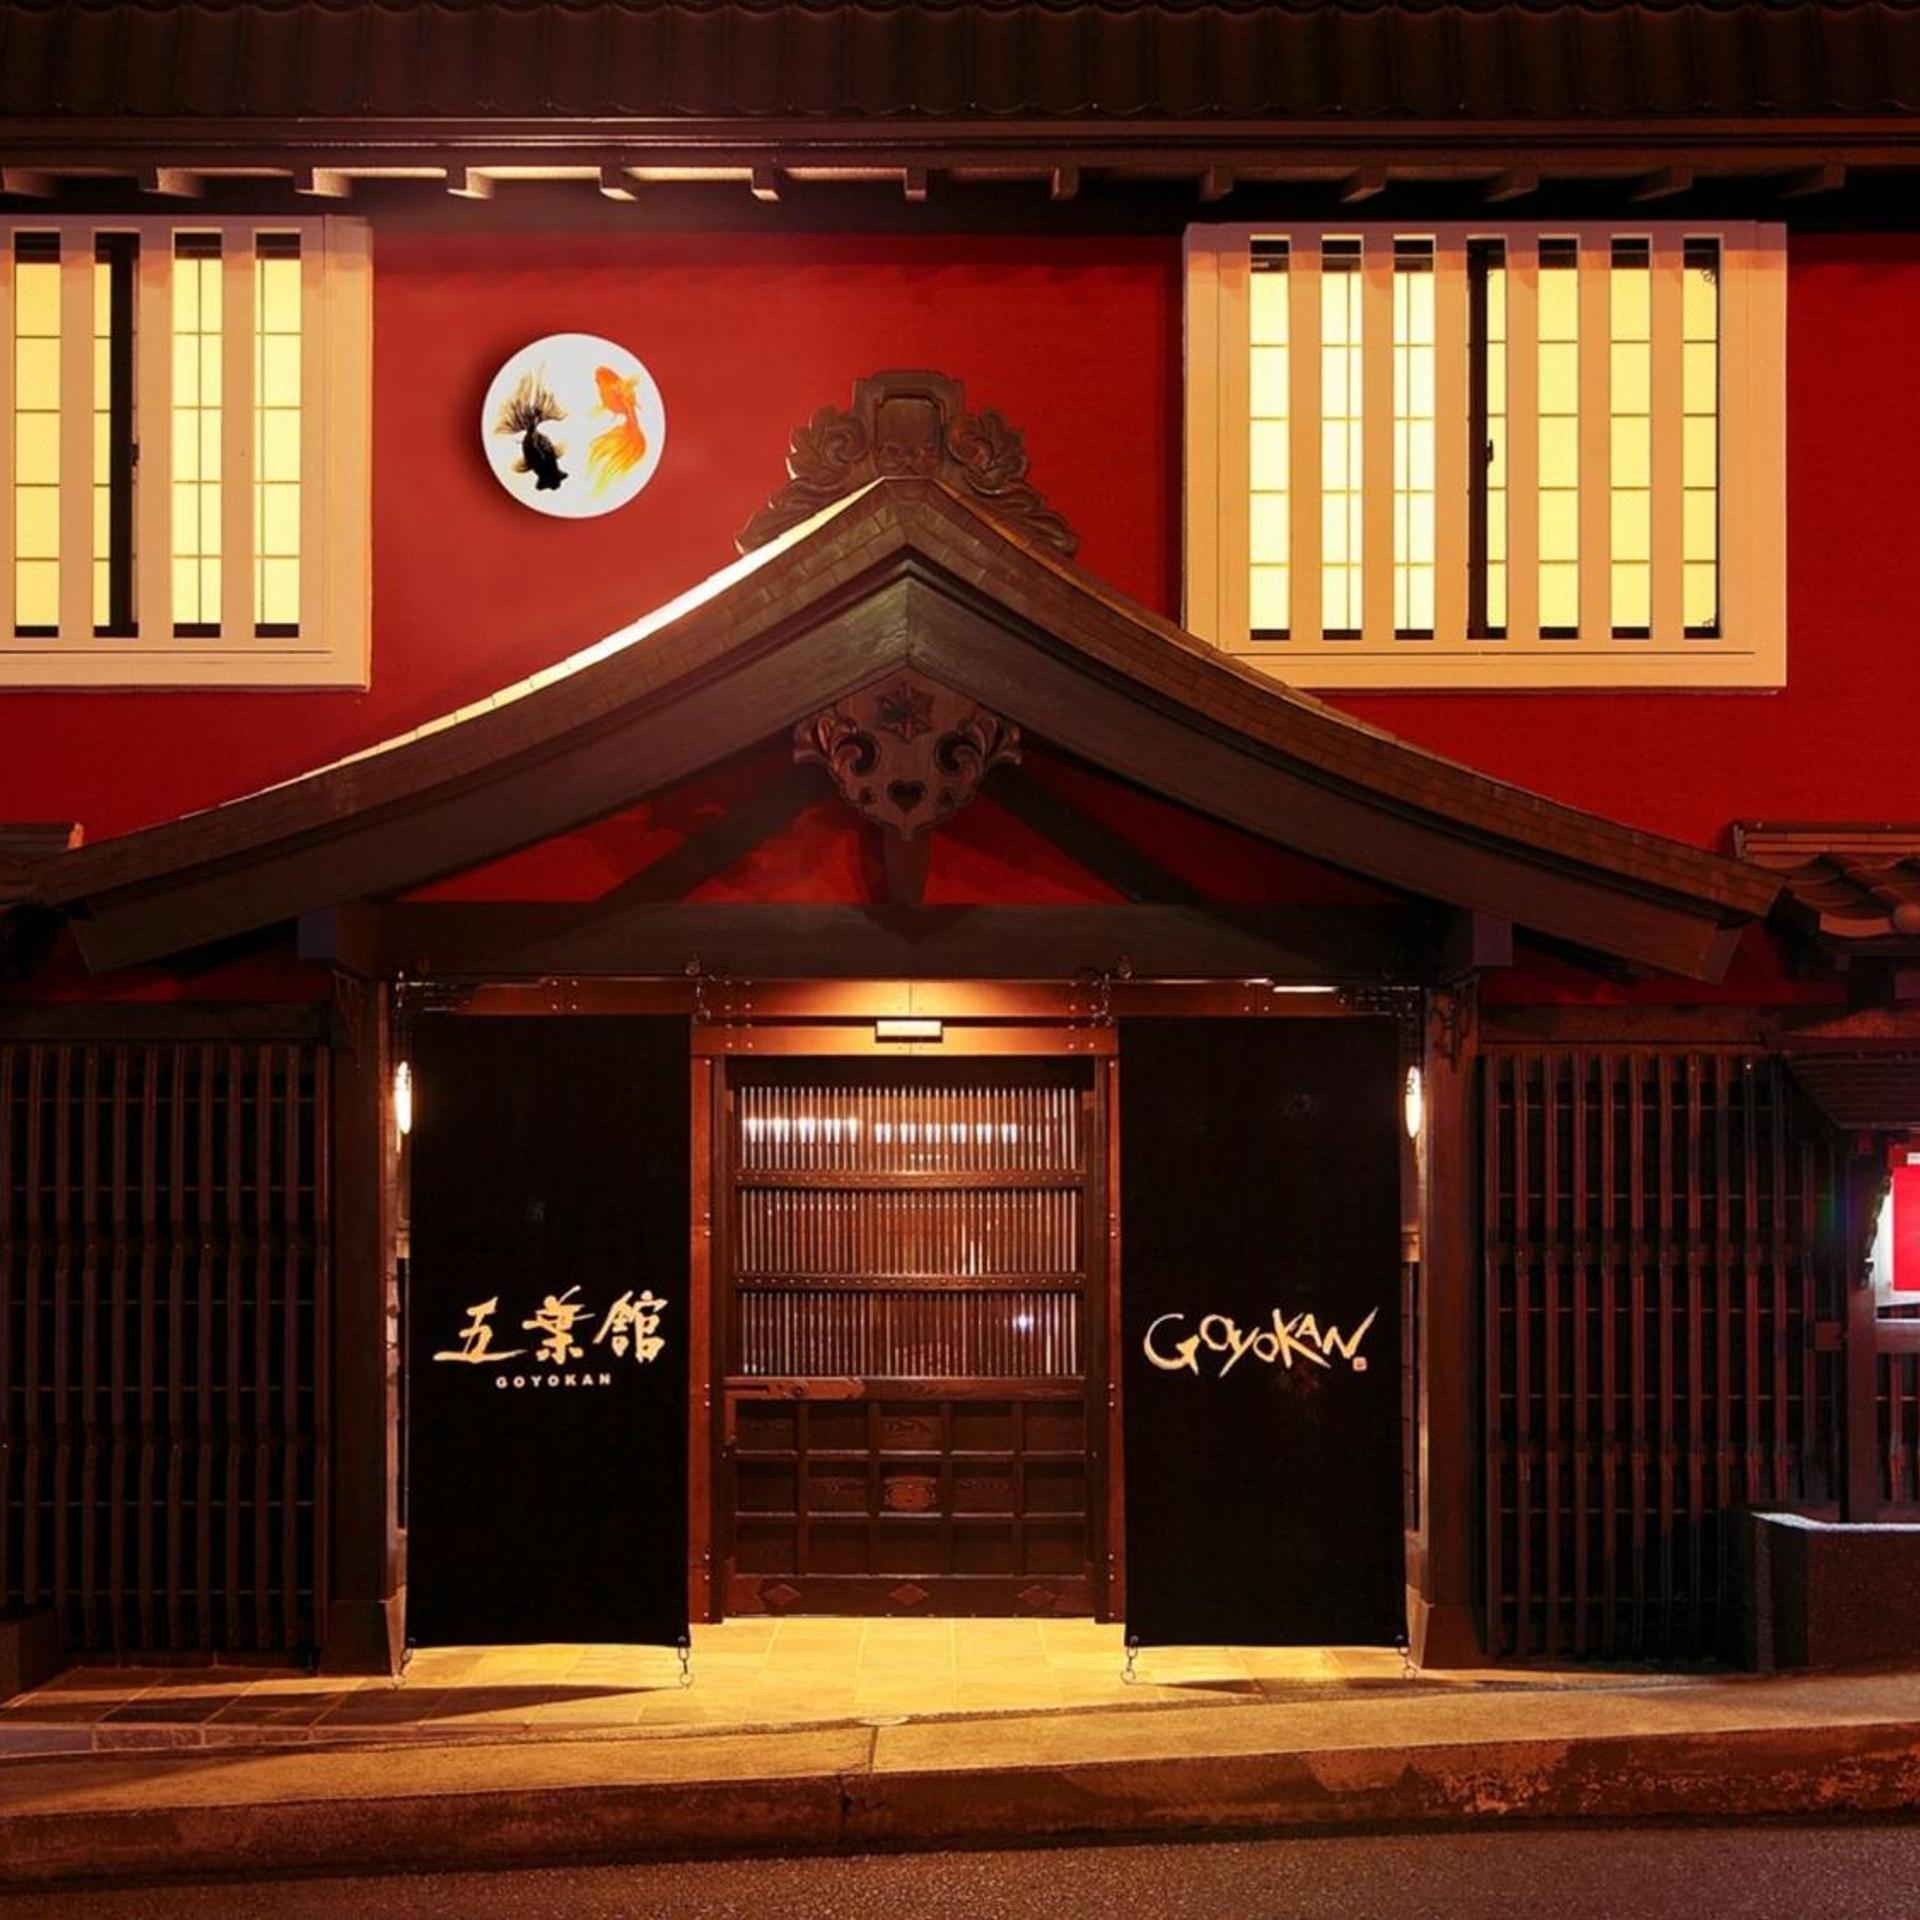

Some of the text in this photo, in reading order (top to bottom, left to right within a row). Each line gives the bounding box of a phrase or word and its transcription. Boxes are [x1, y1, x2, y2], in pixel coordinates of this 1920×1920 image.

[433, 1285, 669, 1366] 五葉館
[1143, 1307, 1379, 1378] GOYOKAN
[495, 1372, 612, 1389] GOYOKAN
